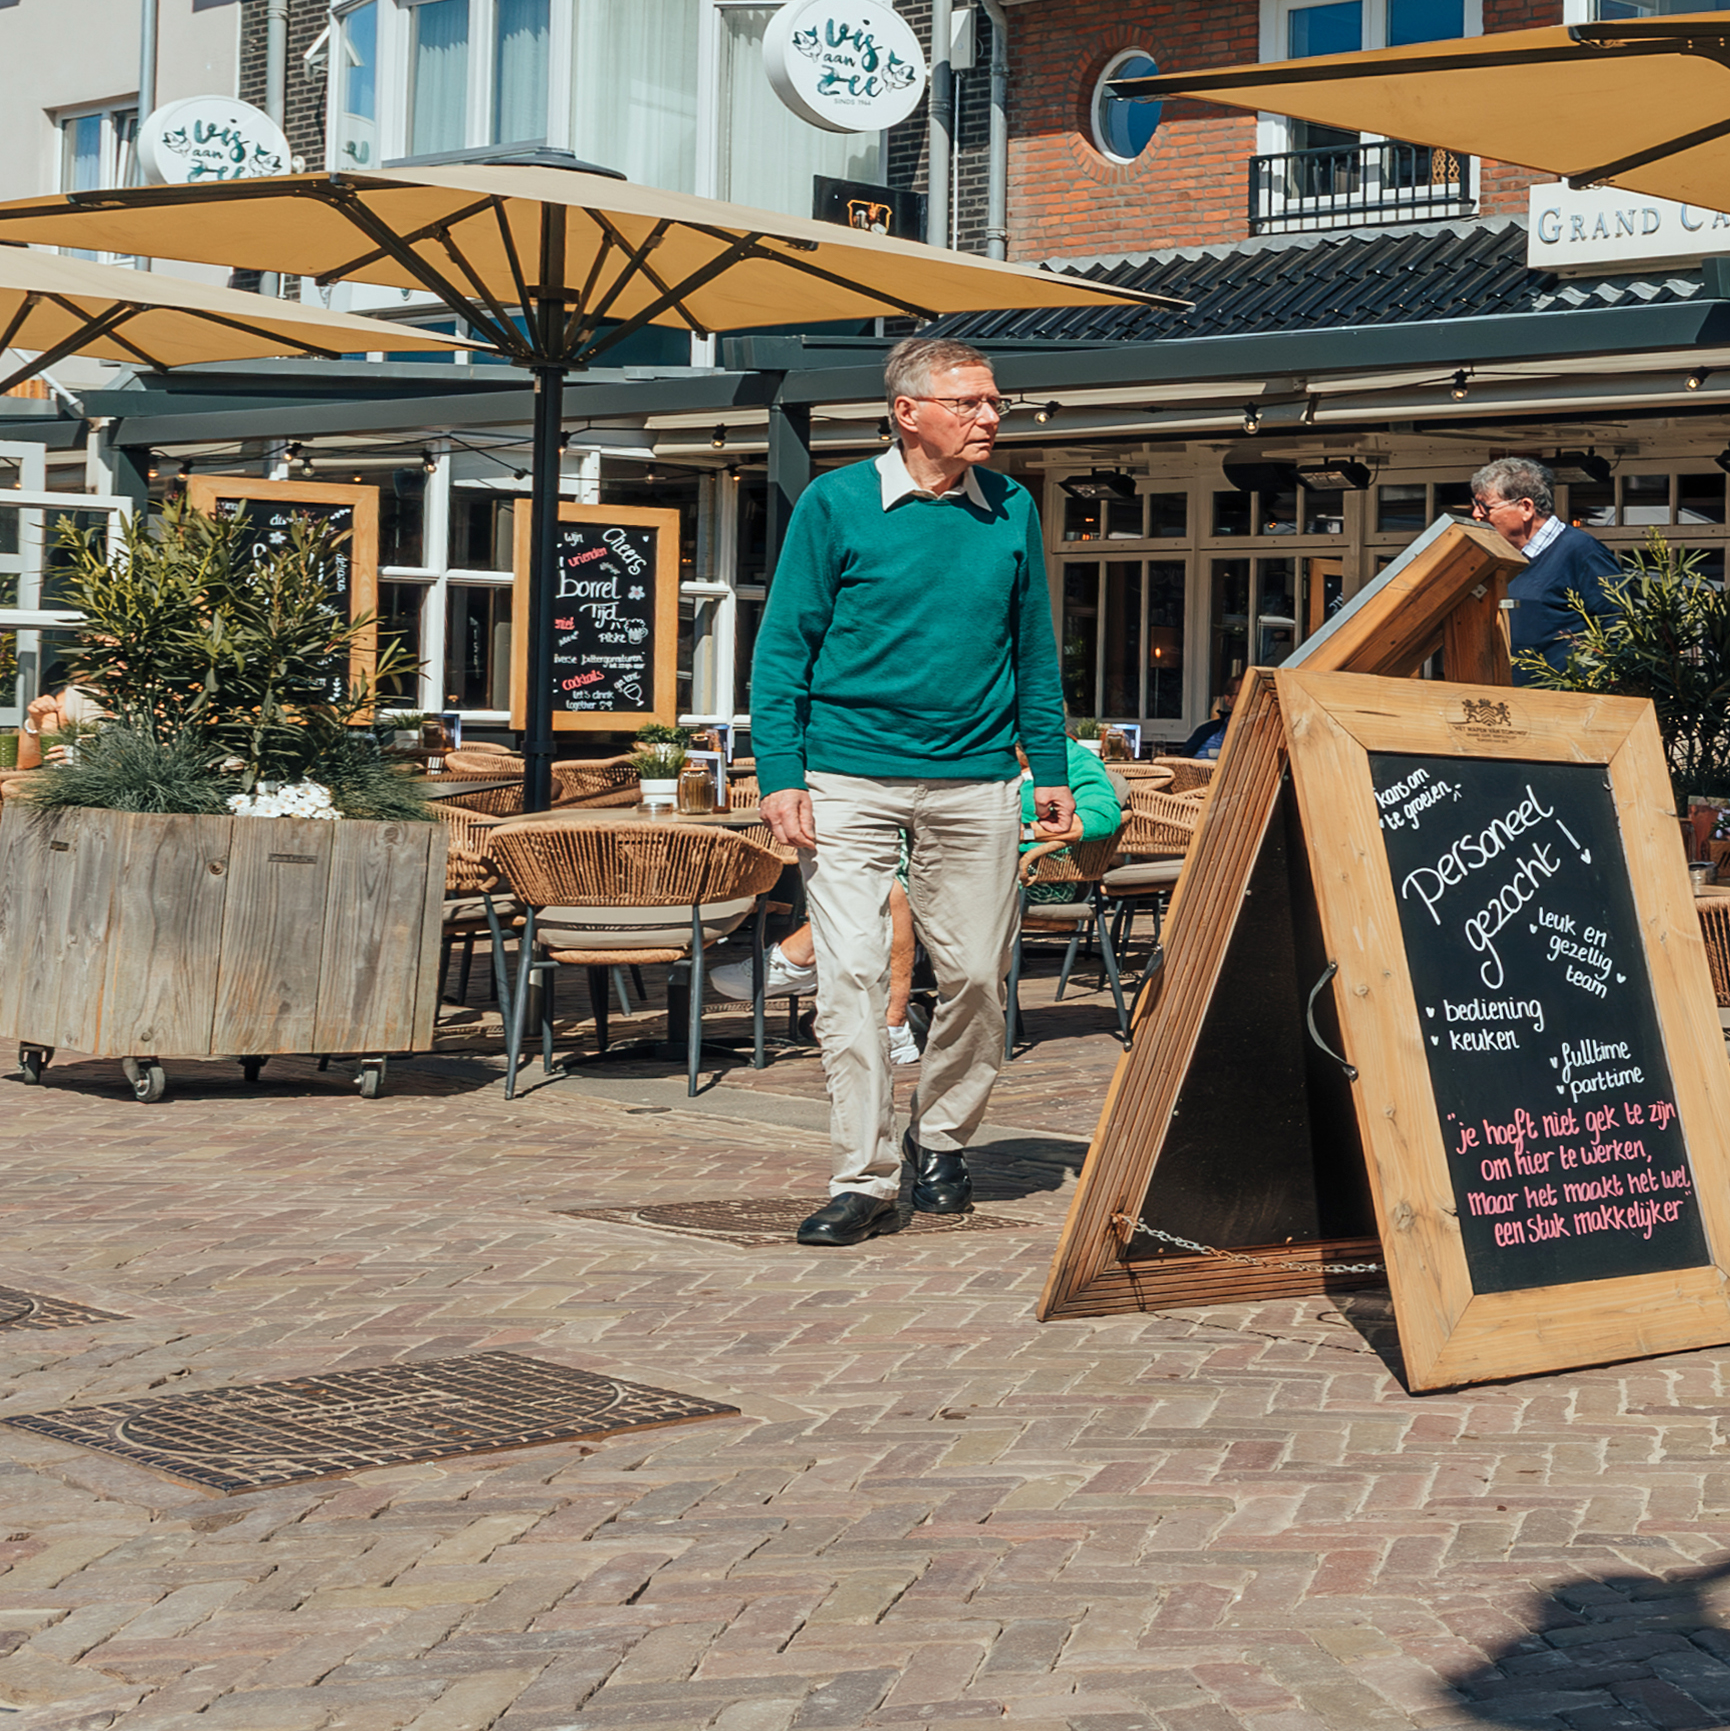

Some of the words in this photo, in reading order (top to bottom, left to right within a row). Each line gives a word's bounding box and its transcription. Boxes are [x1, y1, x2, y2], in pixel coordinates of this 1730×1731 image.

[823, 53, 856, 67] aan
[192, 148, 223, 159] aan
[1538, 207, 1661, 245] GRAND
[602, 528, 647, 575] Cheers
[1374, 781, 1410, 808] kans
[1406, 768, 1430, 789] om
[1384, 811, 1405, 830] te
[1404, 780, 1452, 830] groeien
[1583, 926, 1607, 948] en
[1546, 935, 1613, 981] gezellig
[1566, 965, 1608, 998] team
[1443, 997, 1545, 1032] bediening
[1449, 1028, 1520, 1051] keuken
[1562, 1038, 1631, 1084] fulltime
[1570, 1066, 1645, 1103] parttime
[1483, 1108, 1539, 1153] hoeft
[1542, 1108, 1580, 1138] niet
[1585, 1104, 1620, 1145] gek
[1624, 1102, 1644, 1125] te
[1648, 1100, 1676, 1131] zijn
[1480, 1156, 1513, 1182] om
[1515, 1149, 1555, 1176] hier
[1559, 1144, 1578, 1170] te
[1524, 1183, 1558, 1208] het
[1563, 1174, 1624, 1203] maakt
[1627, 1167, 1659, 1194] het
[1660, 1164, 1691, 1189] wel
[1494, 1220, 1525, 1247] een
[1527, 1213, 1571, 1243] stuk
